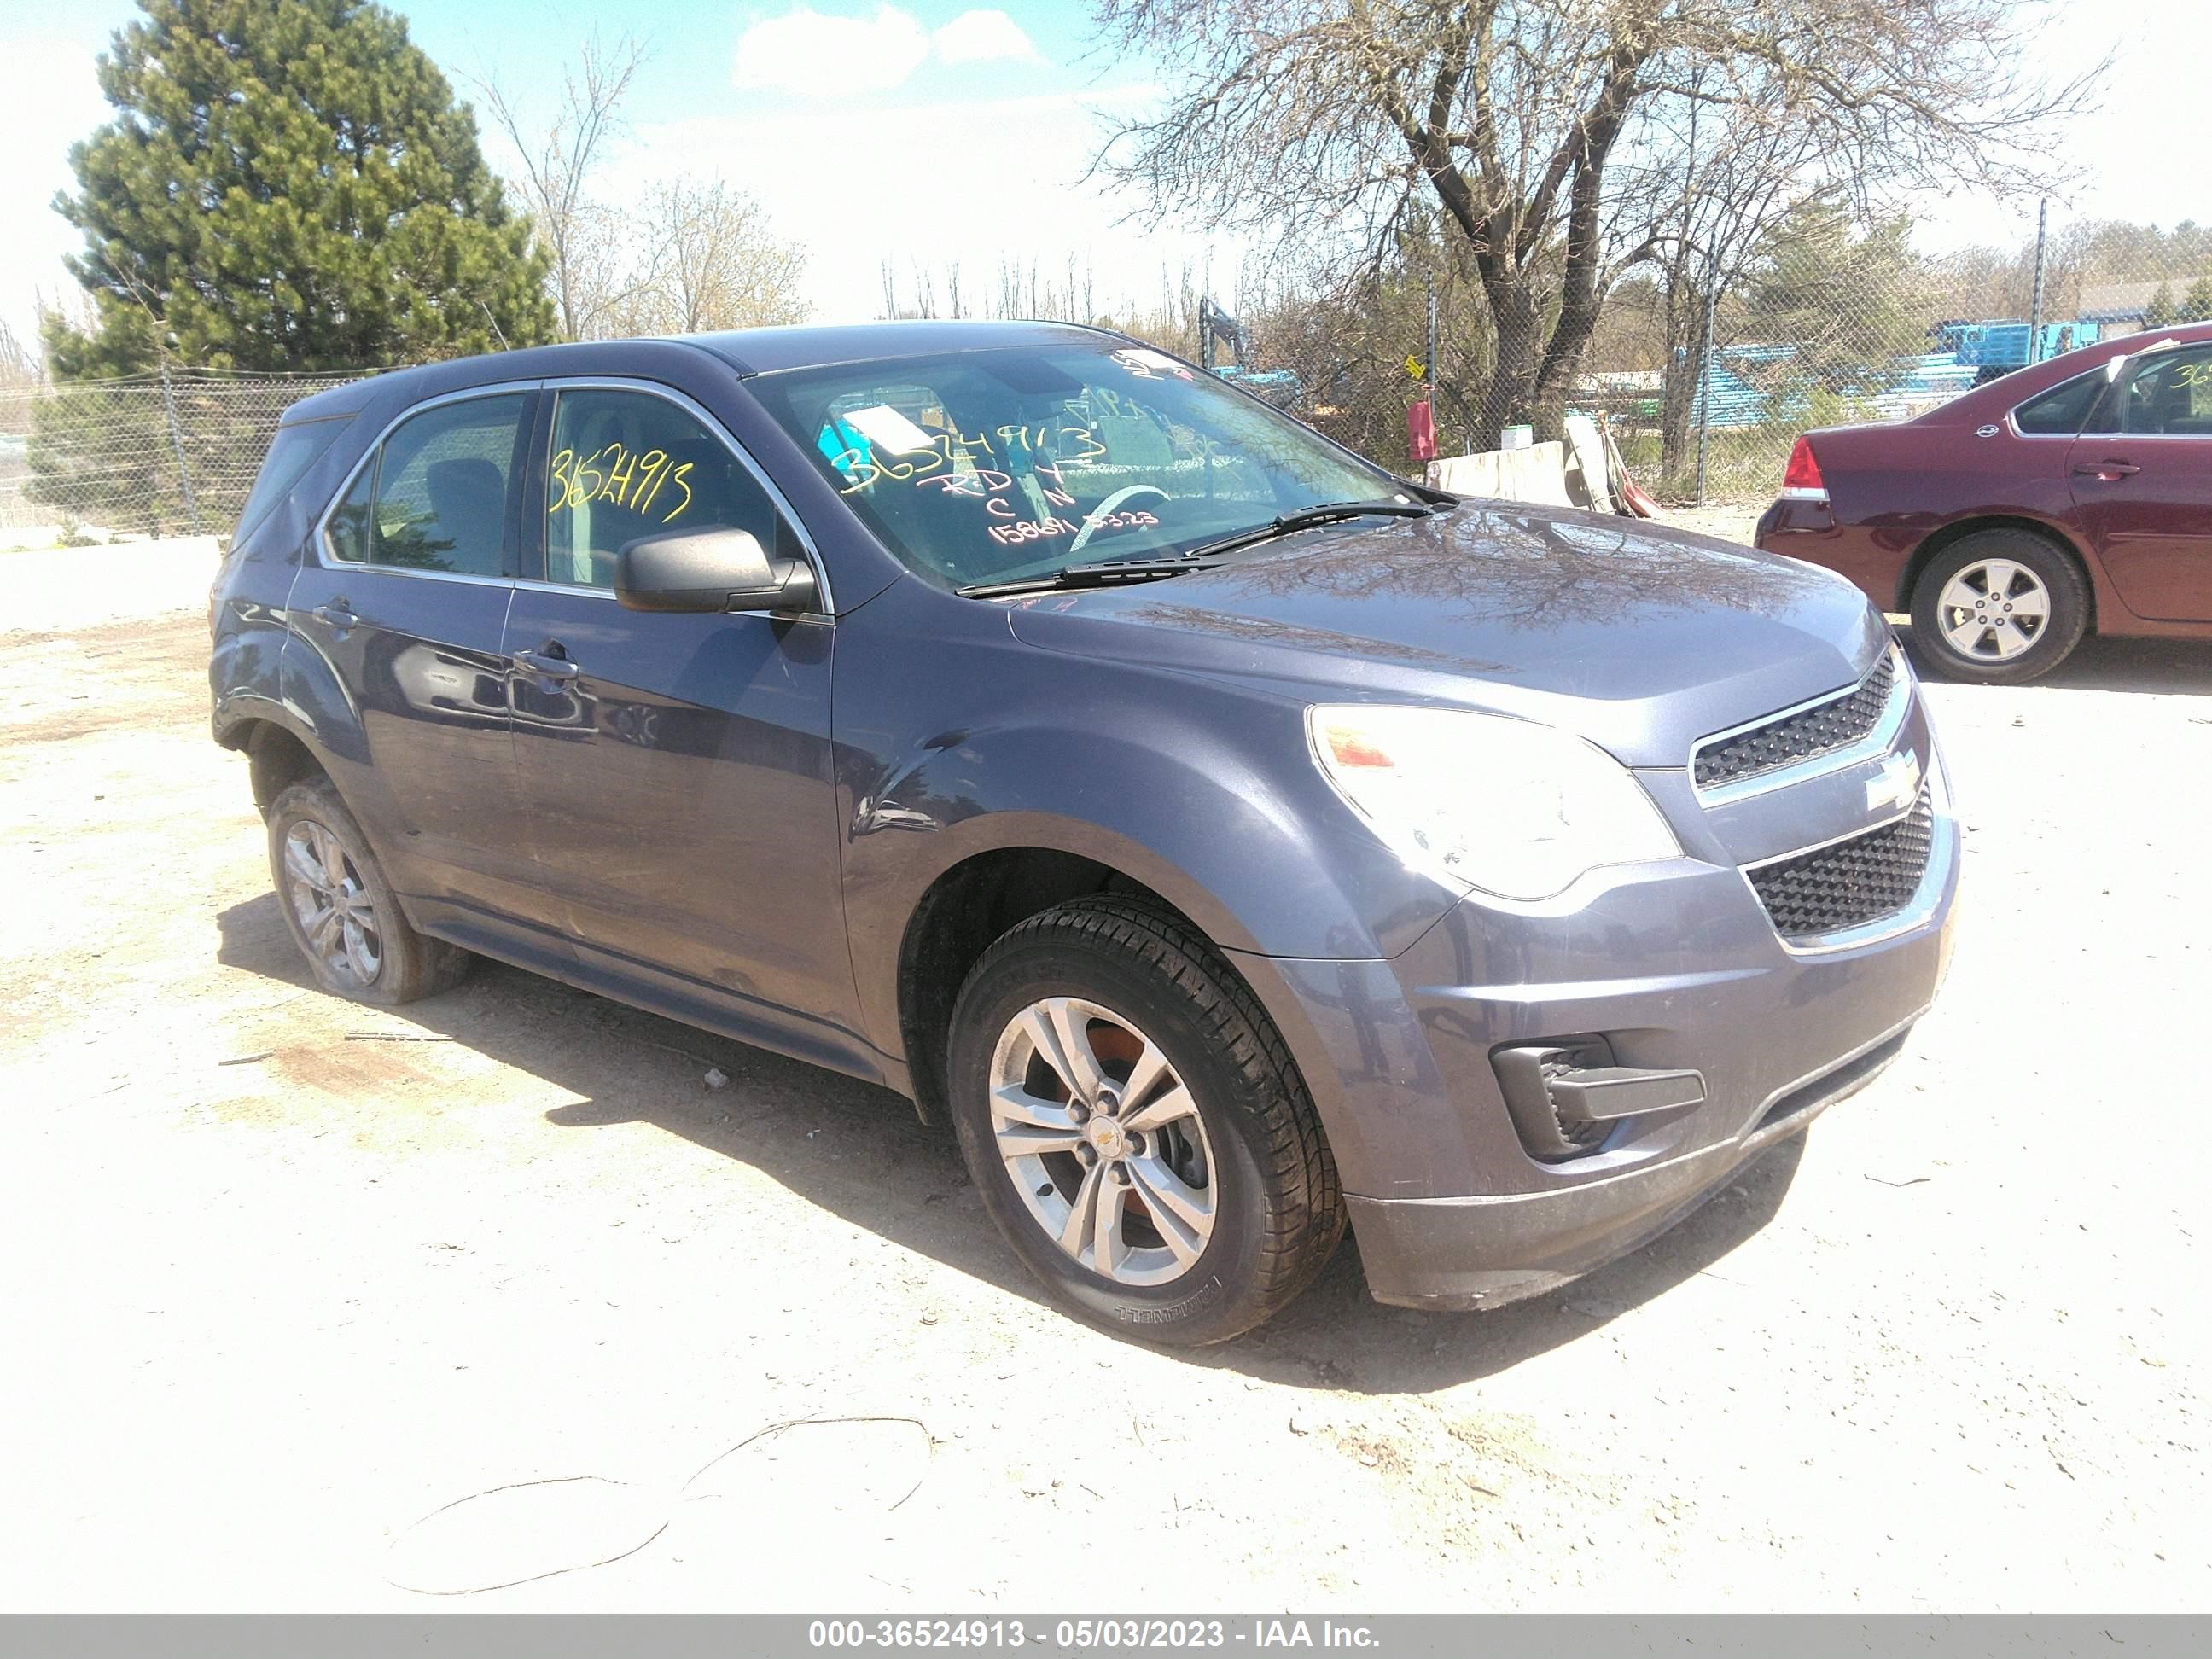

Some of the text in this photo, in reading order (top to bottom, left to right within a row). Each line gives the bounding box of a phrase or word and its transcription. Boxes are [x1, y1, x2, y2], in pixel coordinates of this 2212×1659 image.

[2170, 364, 2212, 388] 36
[986, 486, 1076, 517] C N
